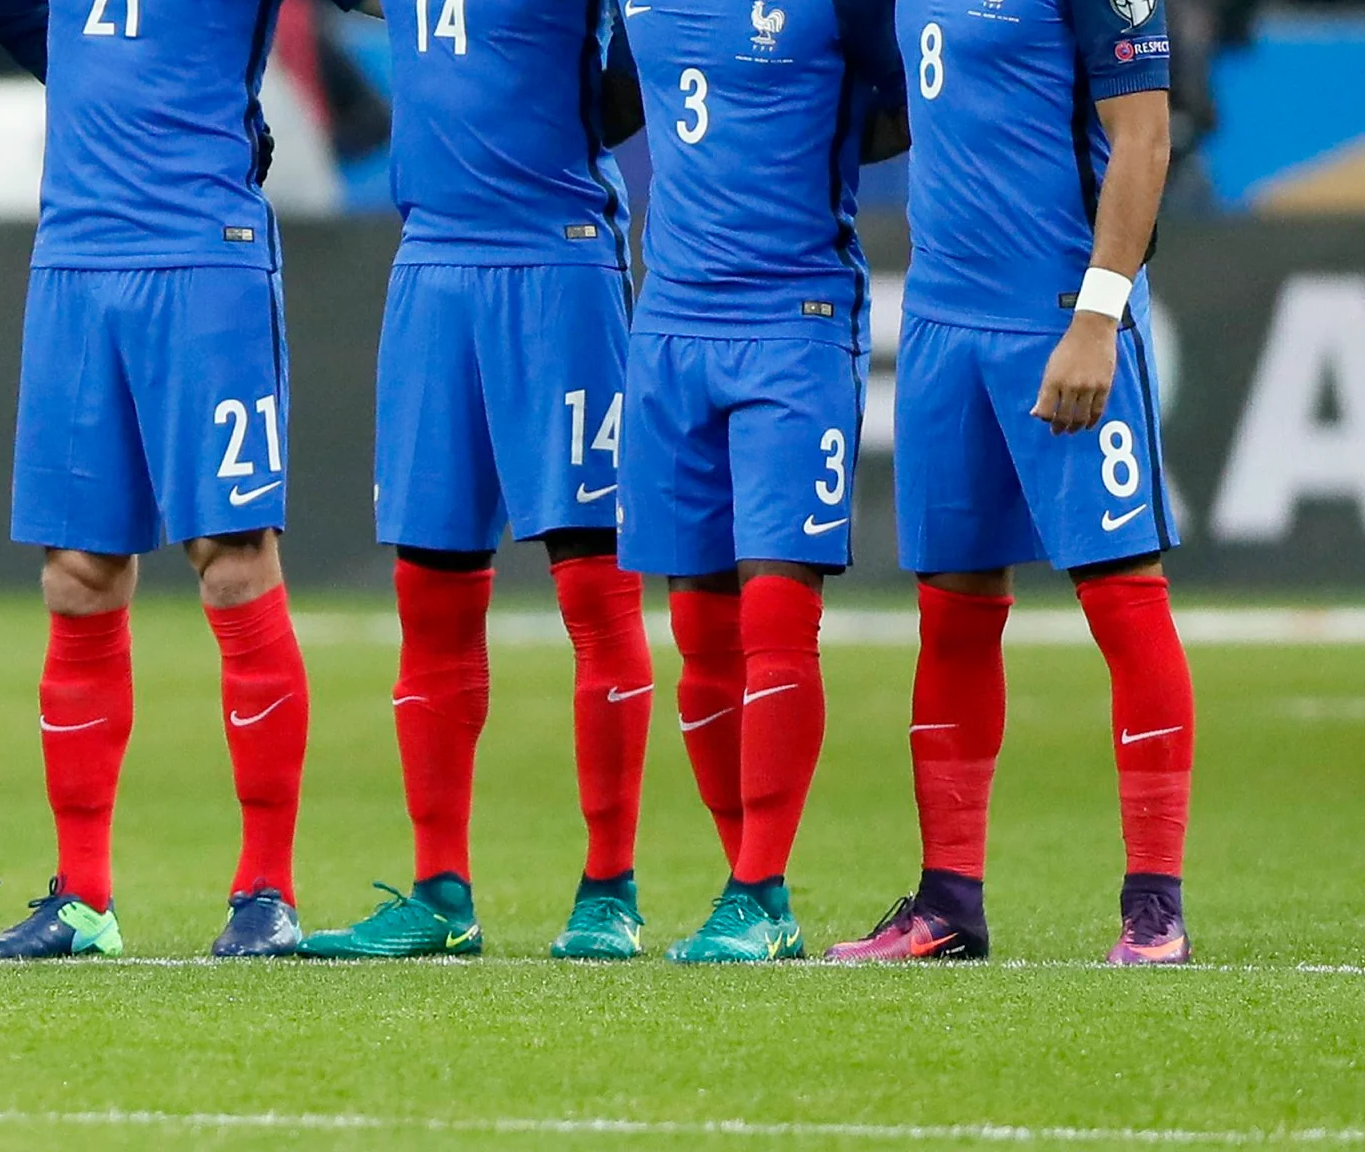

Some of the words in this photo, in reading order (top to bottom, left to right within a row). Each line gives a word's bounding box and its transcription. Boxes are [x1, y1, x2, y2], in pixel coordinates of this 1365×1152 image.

[919, 22, 945, 100] 8
[676, 67, 709, 145] 3
[214, 394, 282, 478] 21
[564, 389, 624, 468] 14
[815, 428, 845, 505] 3
[1098, 420, 1140, 498] 8
